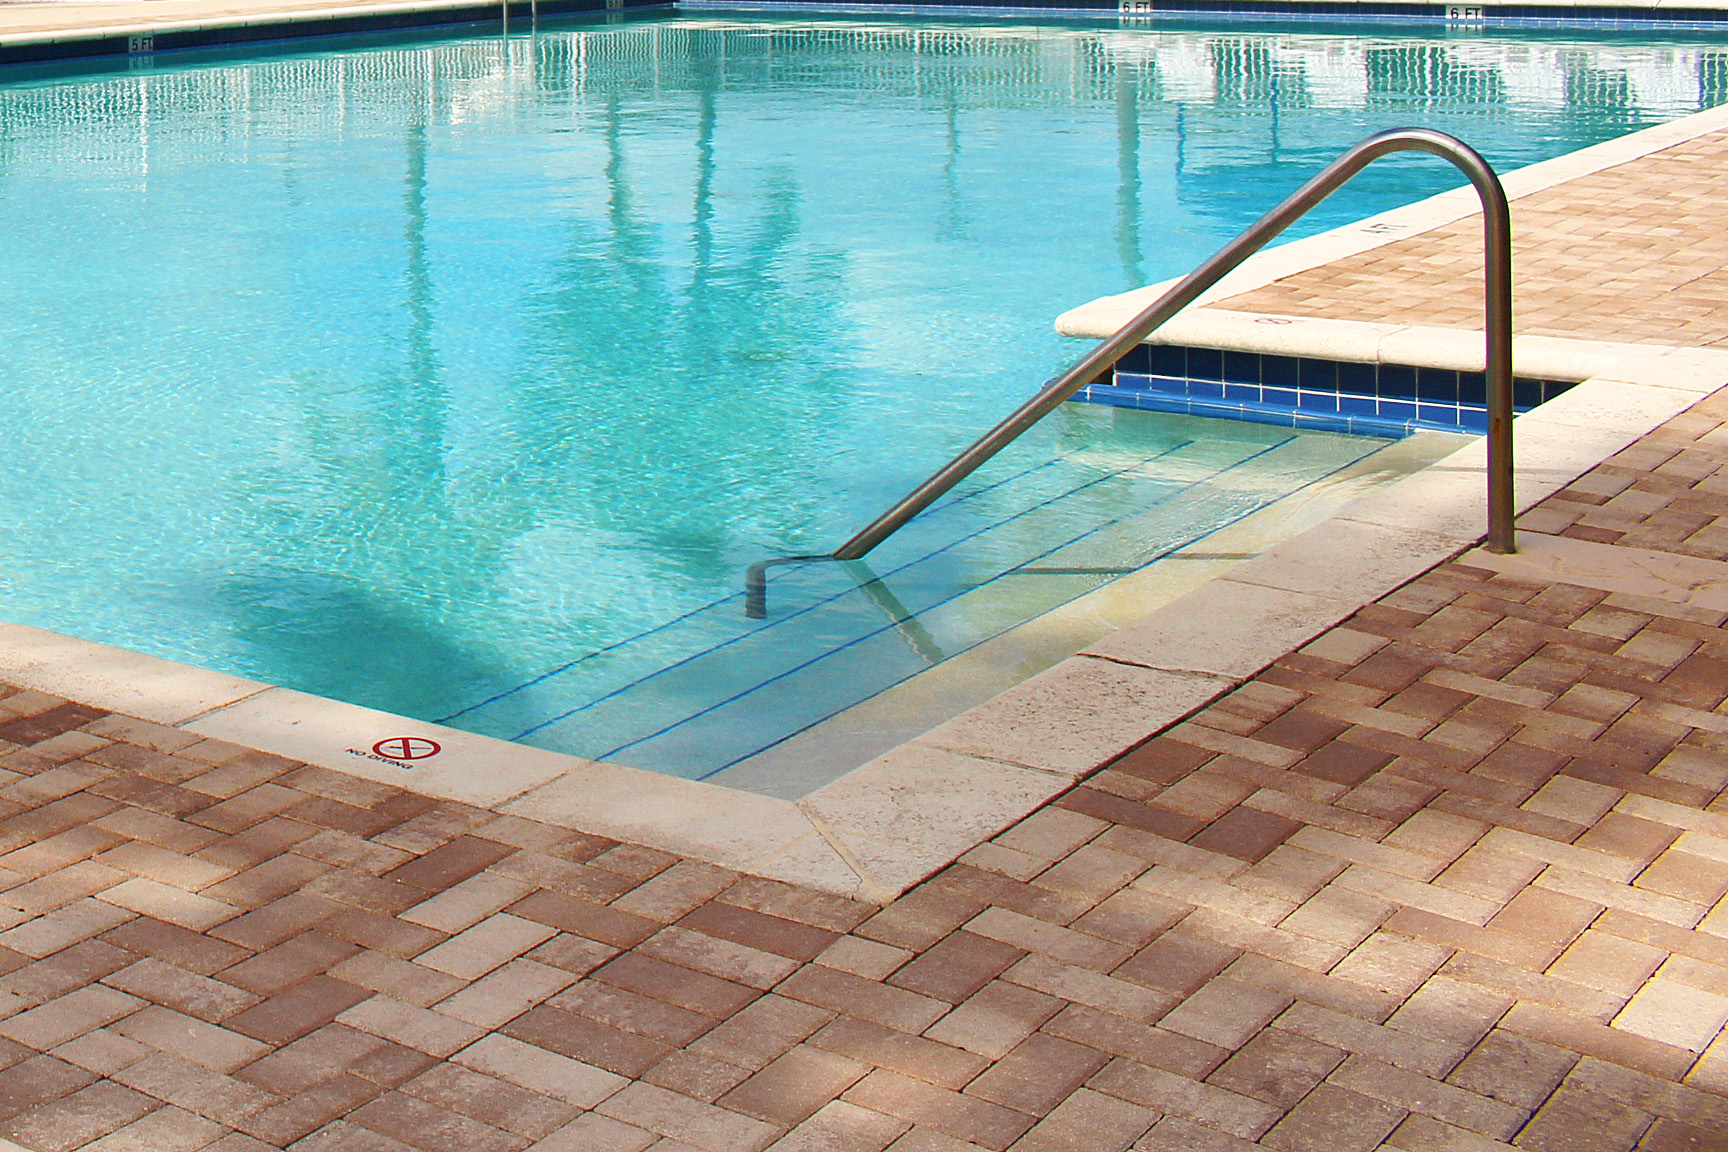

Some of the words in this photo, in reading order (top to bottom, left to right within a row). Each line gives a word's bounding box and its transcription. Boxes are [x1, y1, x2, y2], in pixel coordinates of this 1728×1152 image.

[1123, 1, 1130, 13] 6
[1135, 2, 1149, 13] FT
[1450, 7, 1459, 19] 6
[1465, 8, 1480, 19] FT
[132, 38, 139, 51] 5
[344, 748, 366, 756] NO
[367, 754, 414, 769] DIVING
